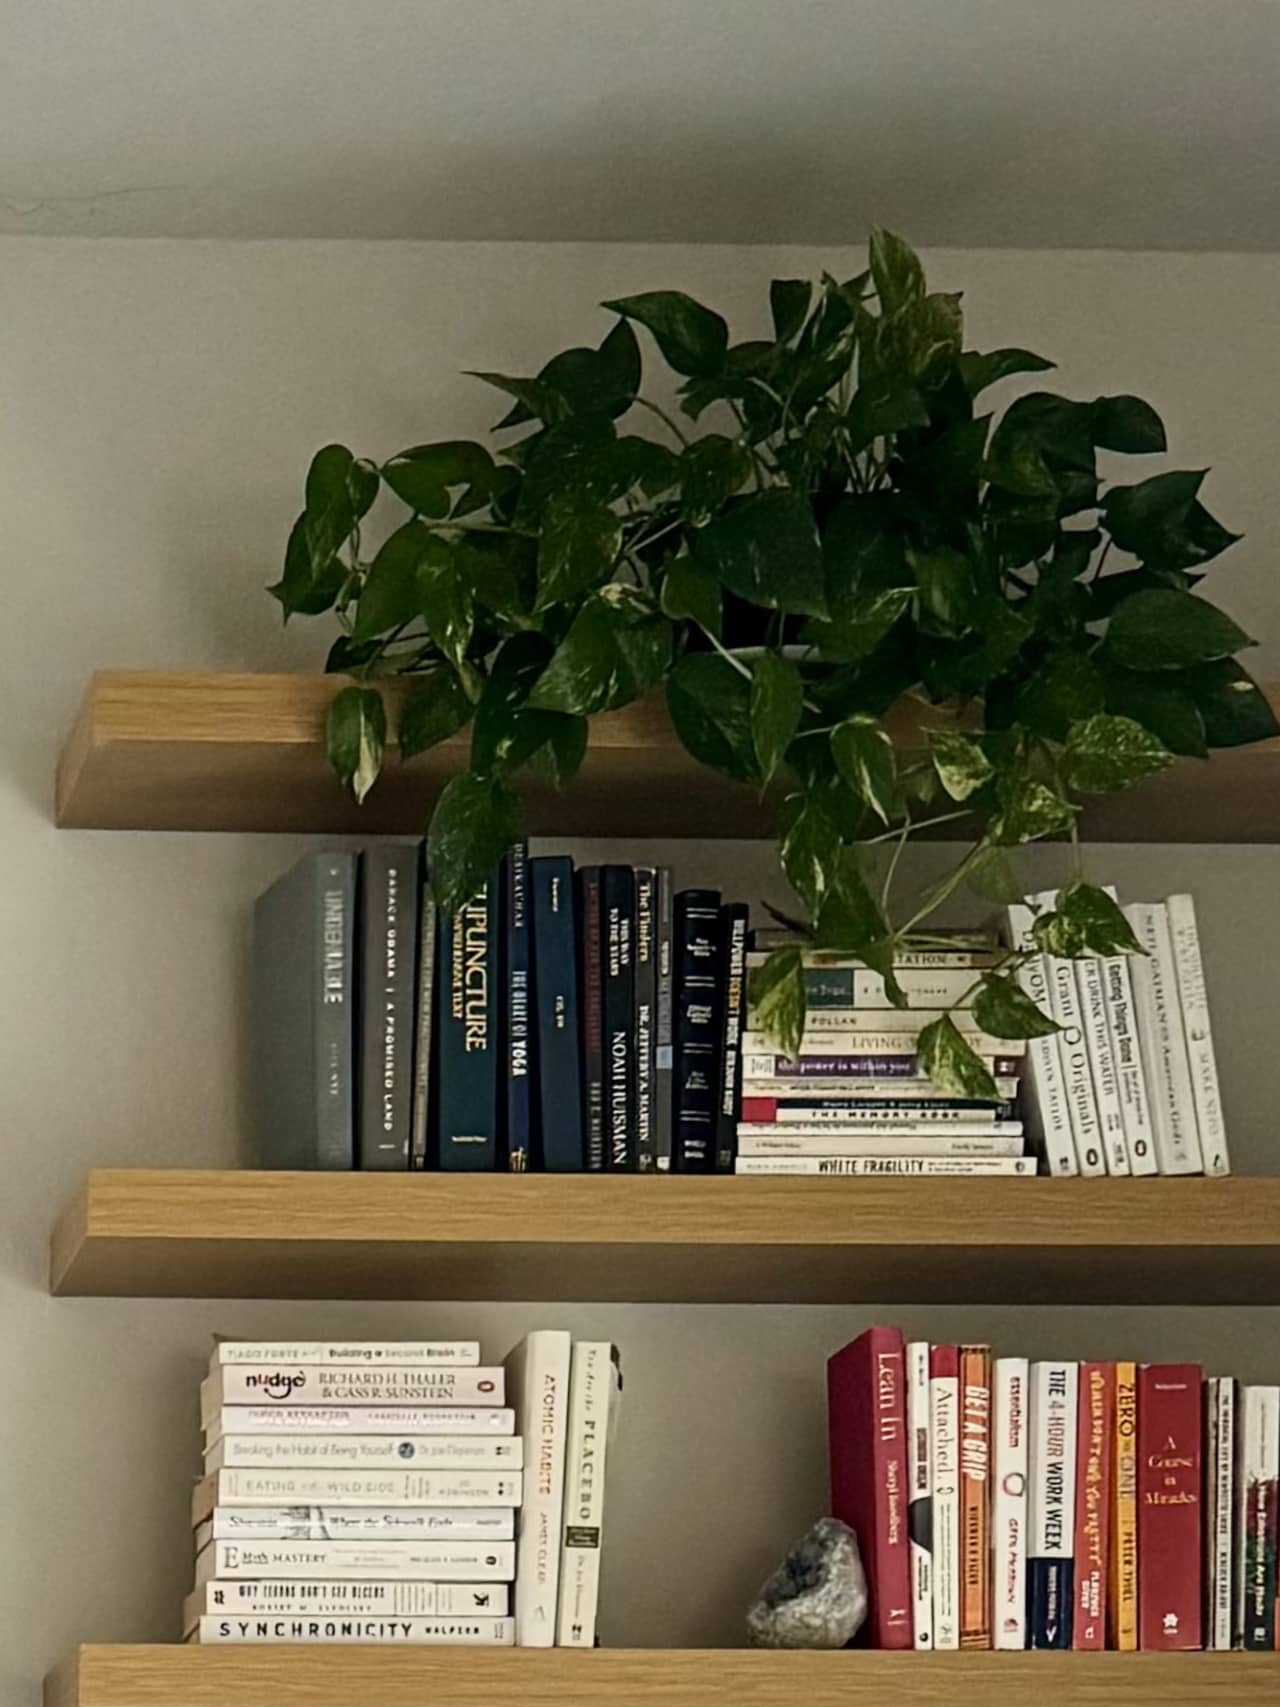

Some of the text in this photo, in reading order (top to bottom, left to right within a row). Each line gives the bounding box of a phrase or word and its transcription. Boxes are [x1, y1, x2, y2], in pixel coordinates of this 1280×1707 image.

[323, 891, 343, 1004] UNDENIABLE
[386, 869, 397, 978] BARACK OBAMA
[639, 883, 652, 962] The Finders
[384, 1016, 394, 1088] PROMISED
[512, 1040, 527, 1076] YOGA
[851, 1037, 902, 1049] LIVING
[1055, 966, 1095, 1135] Grant Originals
[1085, 980, 1114, 1096] DRINK THIS WATER
[1108, 964, 1134, 1063] Getting Things Done
[383, 1094, 393, 1131] LAND
[612, 1031, 627, 1164] NOAH HUISMAN
[818, 1160, 858, 1174] WHITE
[863, 1159, 924, 1174] FRAGILITY
[246, 1370, 307, 1400] nudge
[879, 1352, 902, 1441] Lean In
[1008, 1376, 1022, 1448] essentialism
[538, 1374, 556, 1495] ATOMIC HABITS
[579, 1419, 597, 1520] PLACEBO
[935, 1387, 954, 1480] Attached.
[962, 1385, 989, 1481] GET A GRIP
[1043, 1369, 1067, 1551] THE 4-HOUR WORK WEEK
[1119, 1383, 1136, 1500] ZERO ONE
[246, 1480, 295, 1492] EATING
[272, 1553, 326, 1564] MASTERY
[1122, 1531, 1134, 1567] PETER
